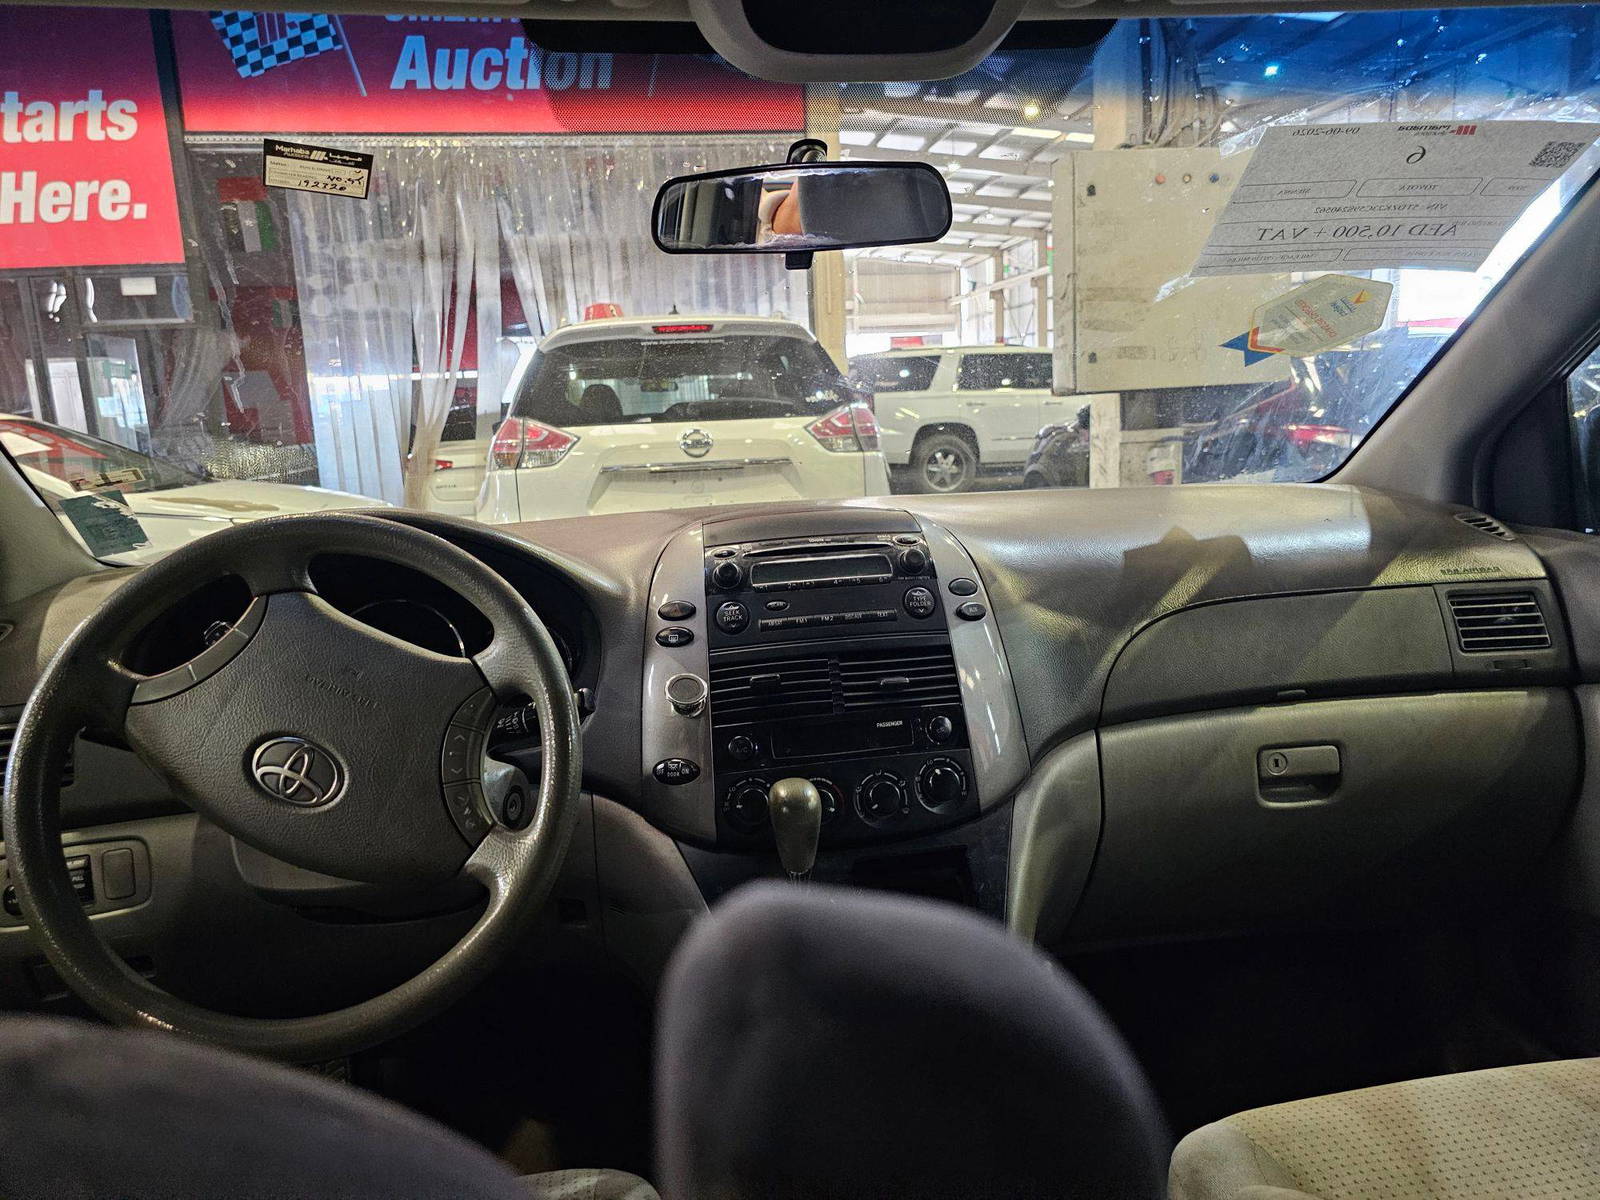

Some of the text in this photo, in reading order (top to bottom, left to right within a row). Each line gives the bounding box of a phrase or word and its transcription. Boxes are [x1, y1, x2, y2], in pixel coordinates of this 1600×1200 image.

[390, 35, 614, 90] Auction
[0, 90, 138, 143] tarts
[275, 144, 310, 157] Marhaba
[0, 170, 148, 224] Here.
[876, 720, 903, 728] PASSENGER
